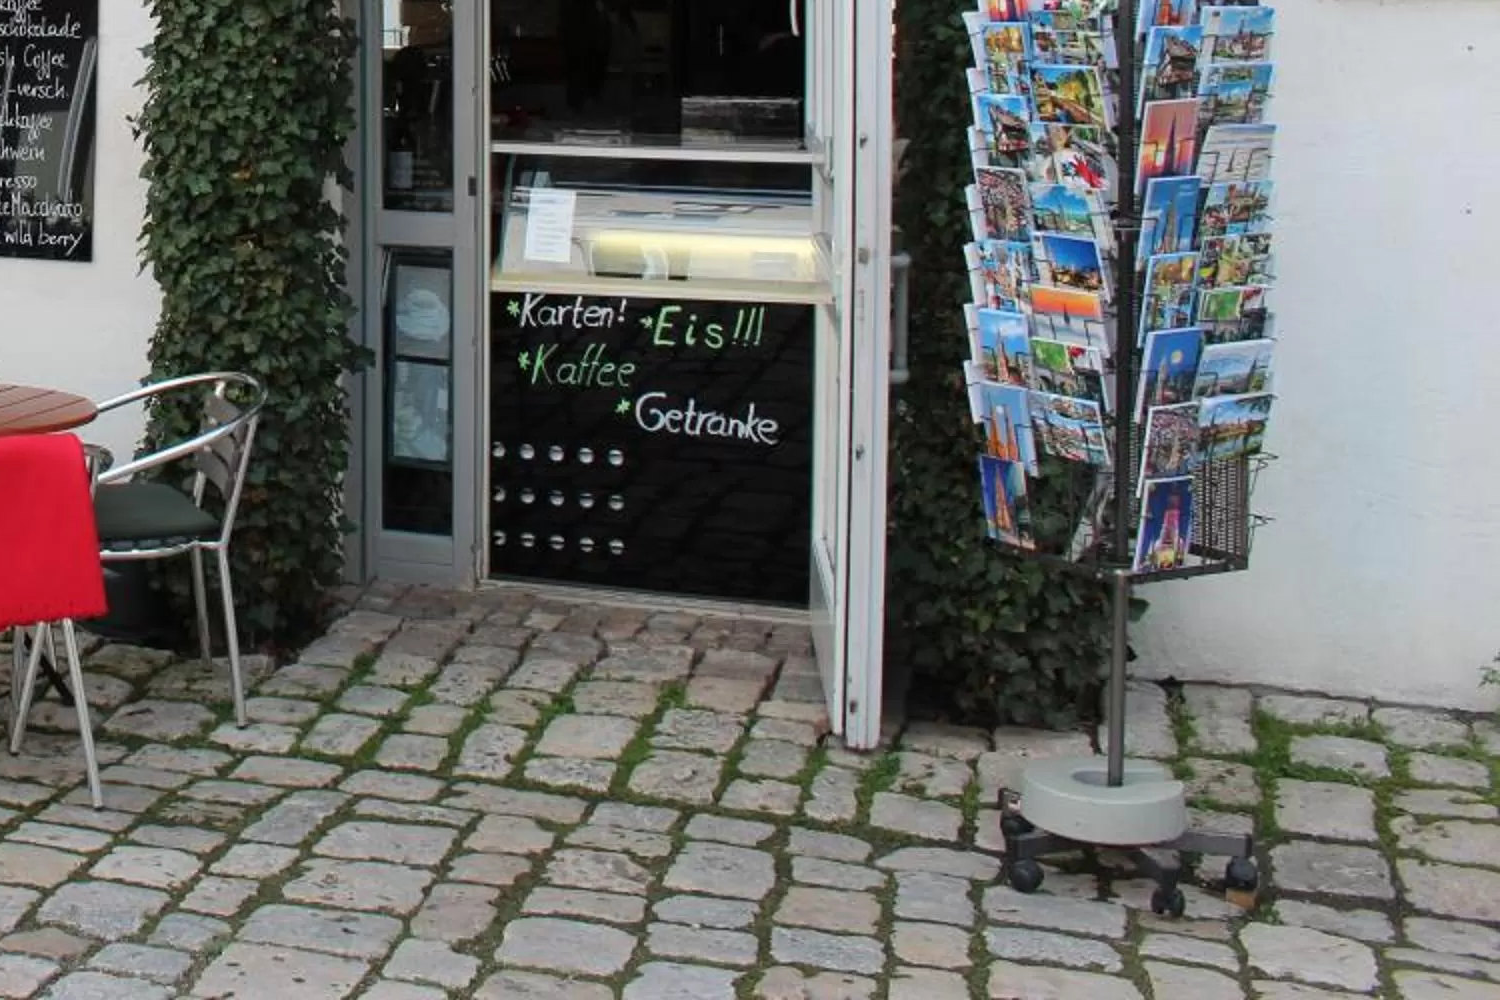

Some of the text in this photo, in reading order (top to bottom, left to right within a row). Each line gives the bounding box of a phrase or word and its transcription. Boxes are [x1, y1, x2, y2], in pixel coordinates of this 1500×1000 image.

[38, 220, 85, 256] berry
[519, 293, 627, 329] Karten!
[531, 343, 637, 387] Kaffee
